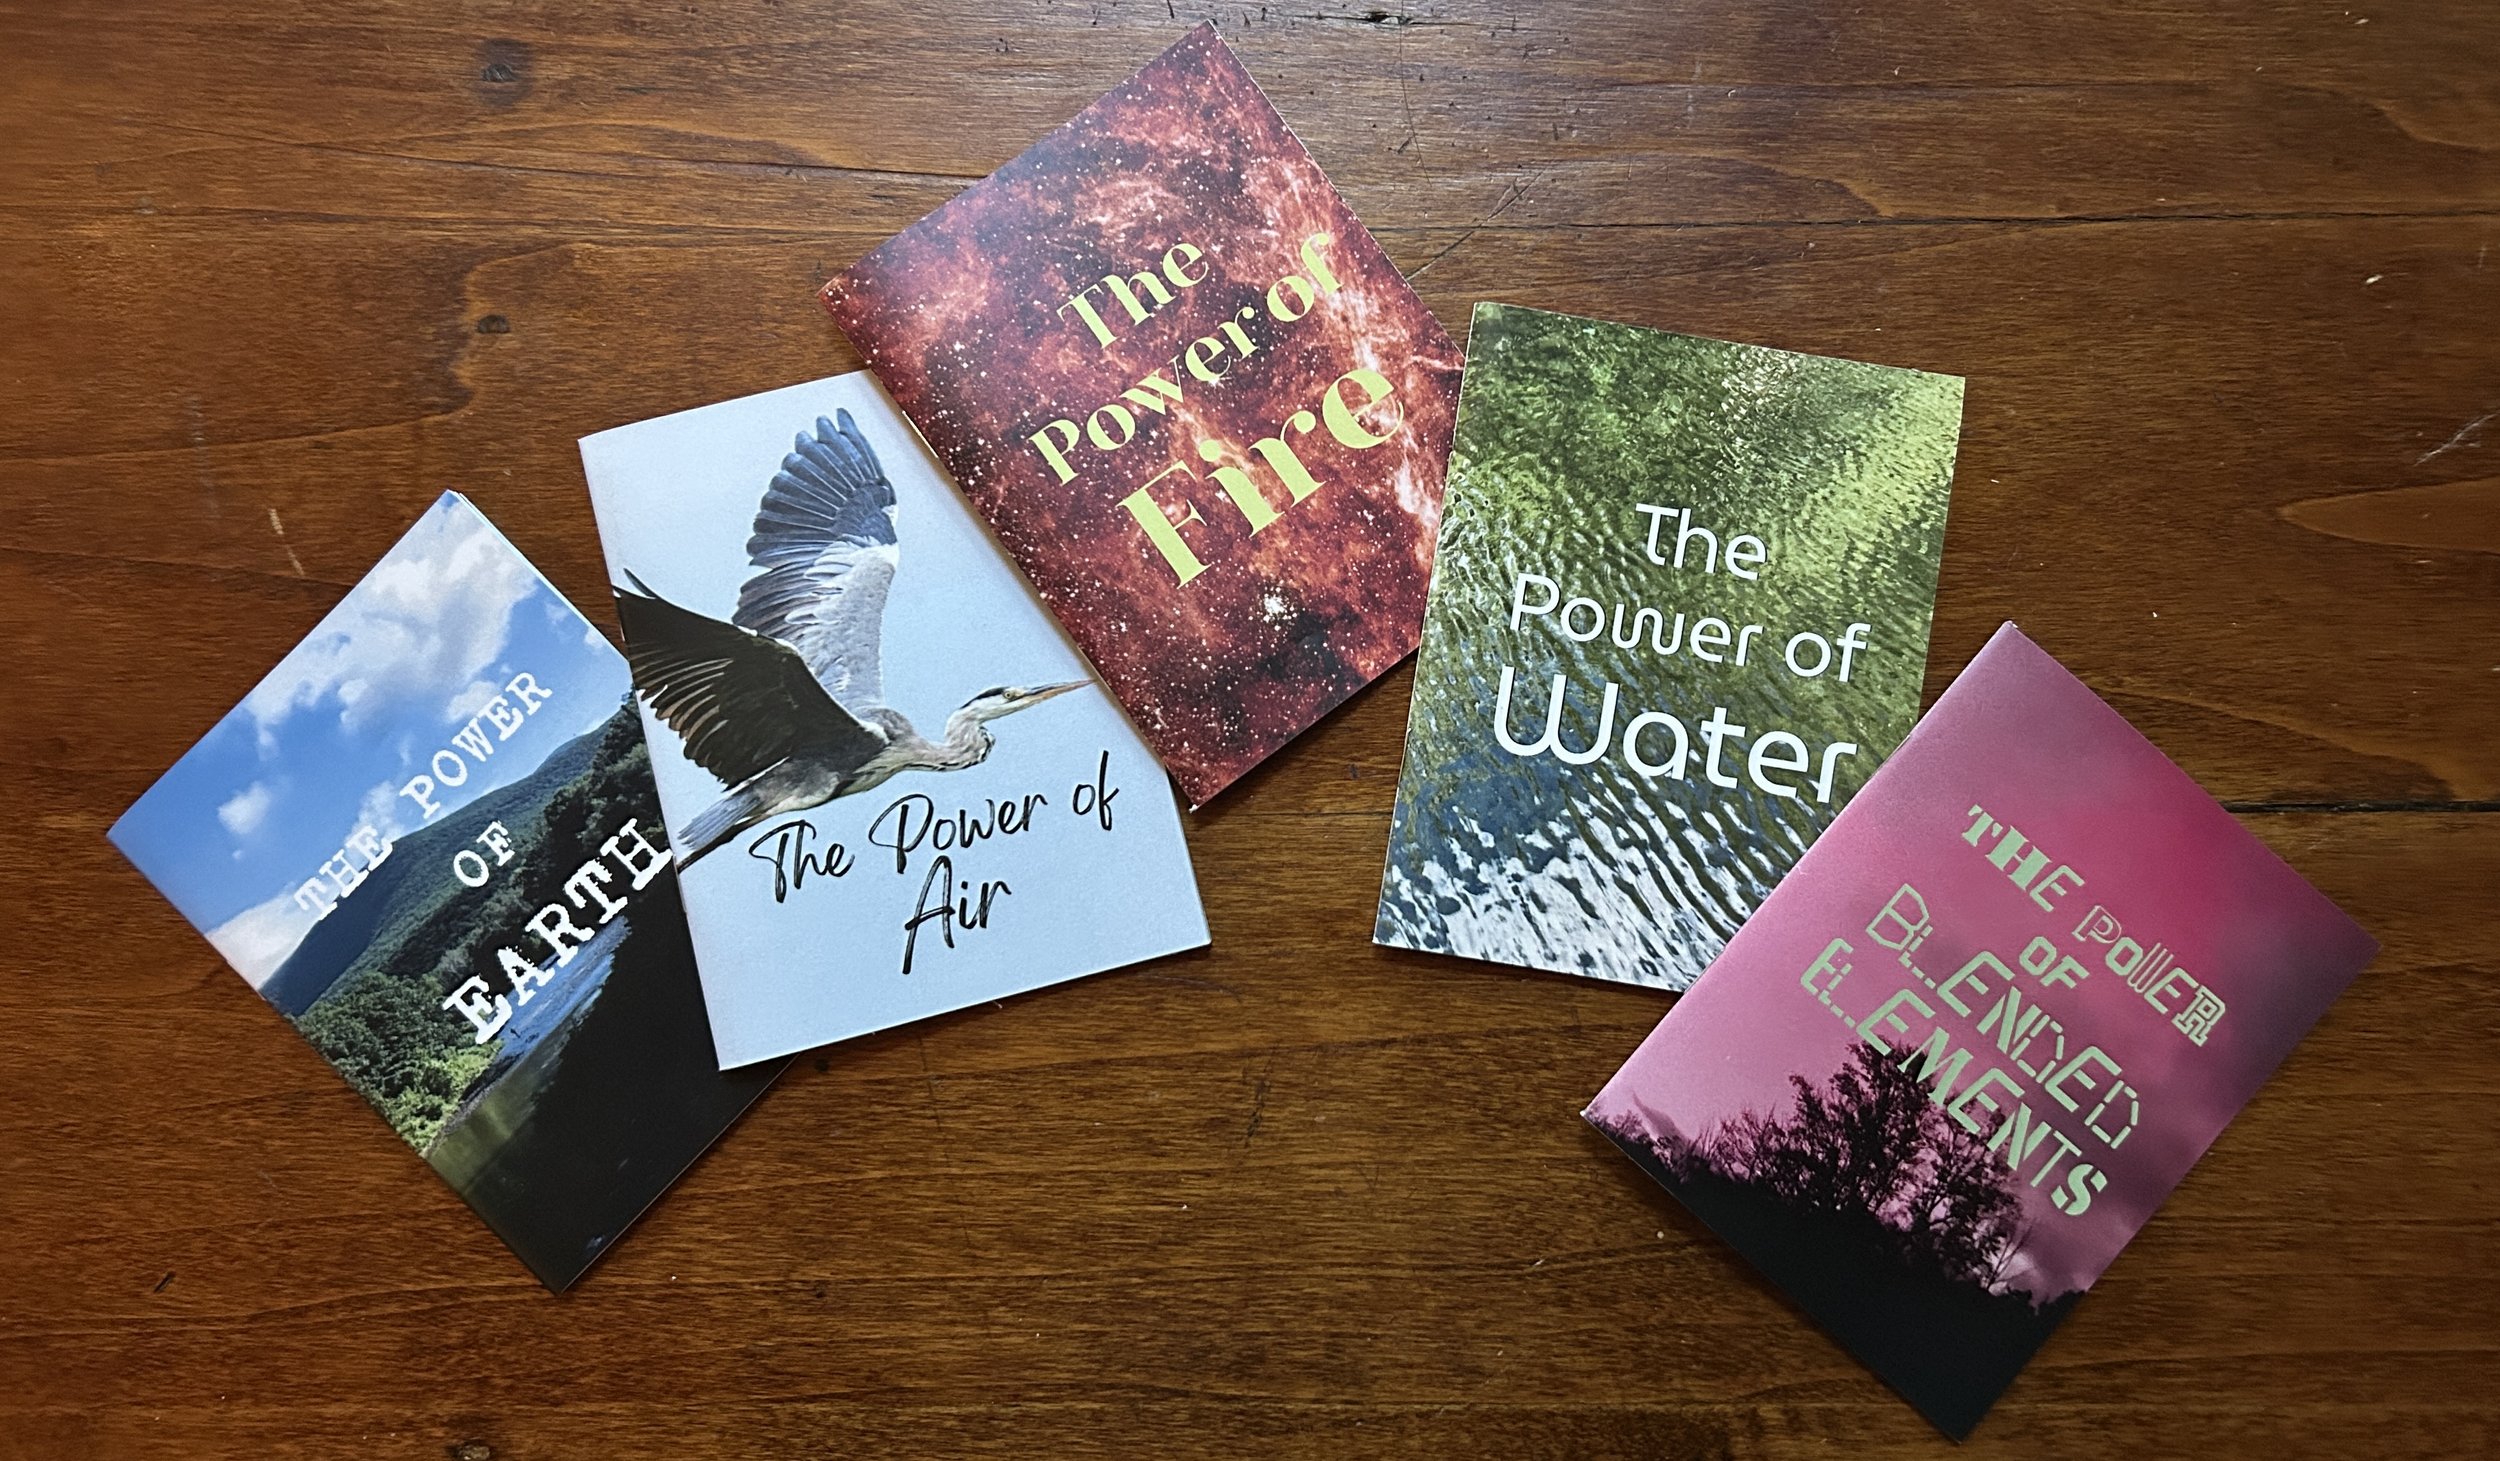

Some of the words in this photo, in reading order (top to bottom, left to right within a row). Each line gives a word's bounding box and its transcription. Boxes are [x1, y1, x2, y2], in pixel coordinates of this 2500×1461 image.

[1028, 306, 1259, 486] Power
[1267, 232, 1343, 322] of
[1056, 242, 1209, 349] The
[1117, 368, 1404, 589] Fire
[1635, 503, 1767, 580] The
[1510, 573, 1763, 666] Power
[1785, 623, 1872, 682] of
[294, 826, 394, 920] THE
[400, 672, 552, 818] POWER
[1493, 665, 1858, 803] Water
[453, 821, 516, 887] OF
[749, 820, 855, 903] The
[868, 794, 1048, 874] Power
[1072, 750, 1119, 831] of
[443, 818, 674, 1044] EARTH
[904, 855, 1012, 974] Air
[1961, 804, 2085, 912] THE
[2072, 905, 2226, 1047] POWER
[2019, 936, 2089, 989] OF
[1800, 938, 2108, 1216] ELEMENTS
[1866, 883, 2139, 1149] BLENDED
